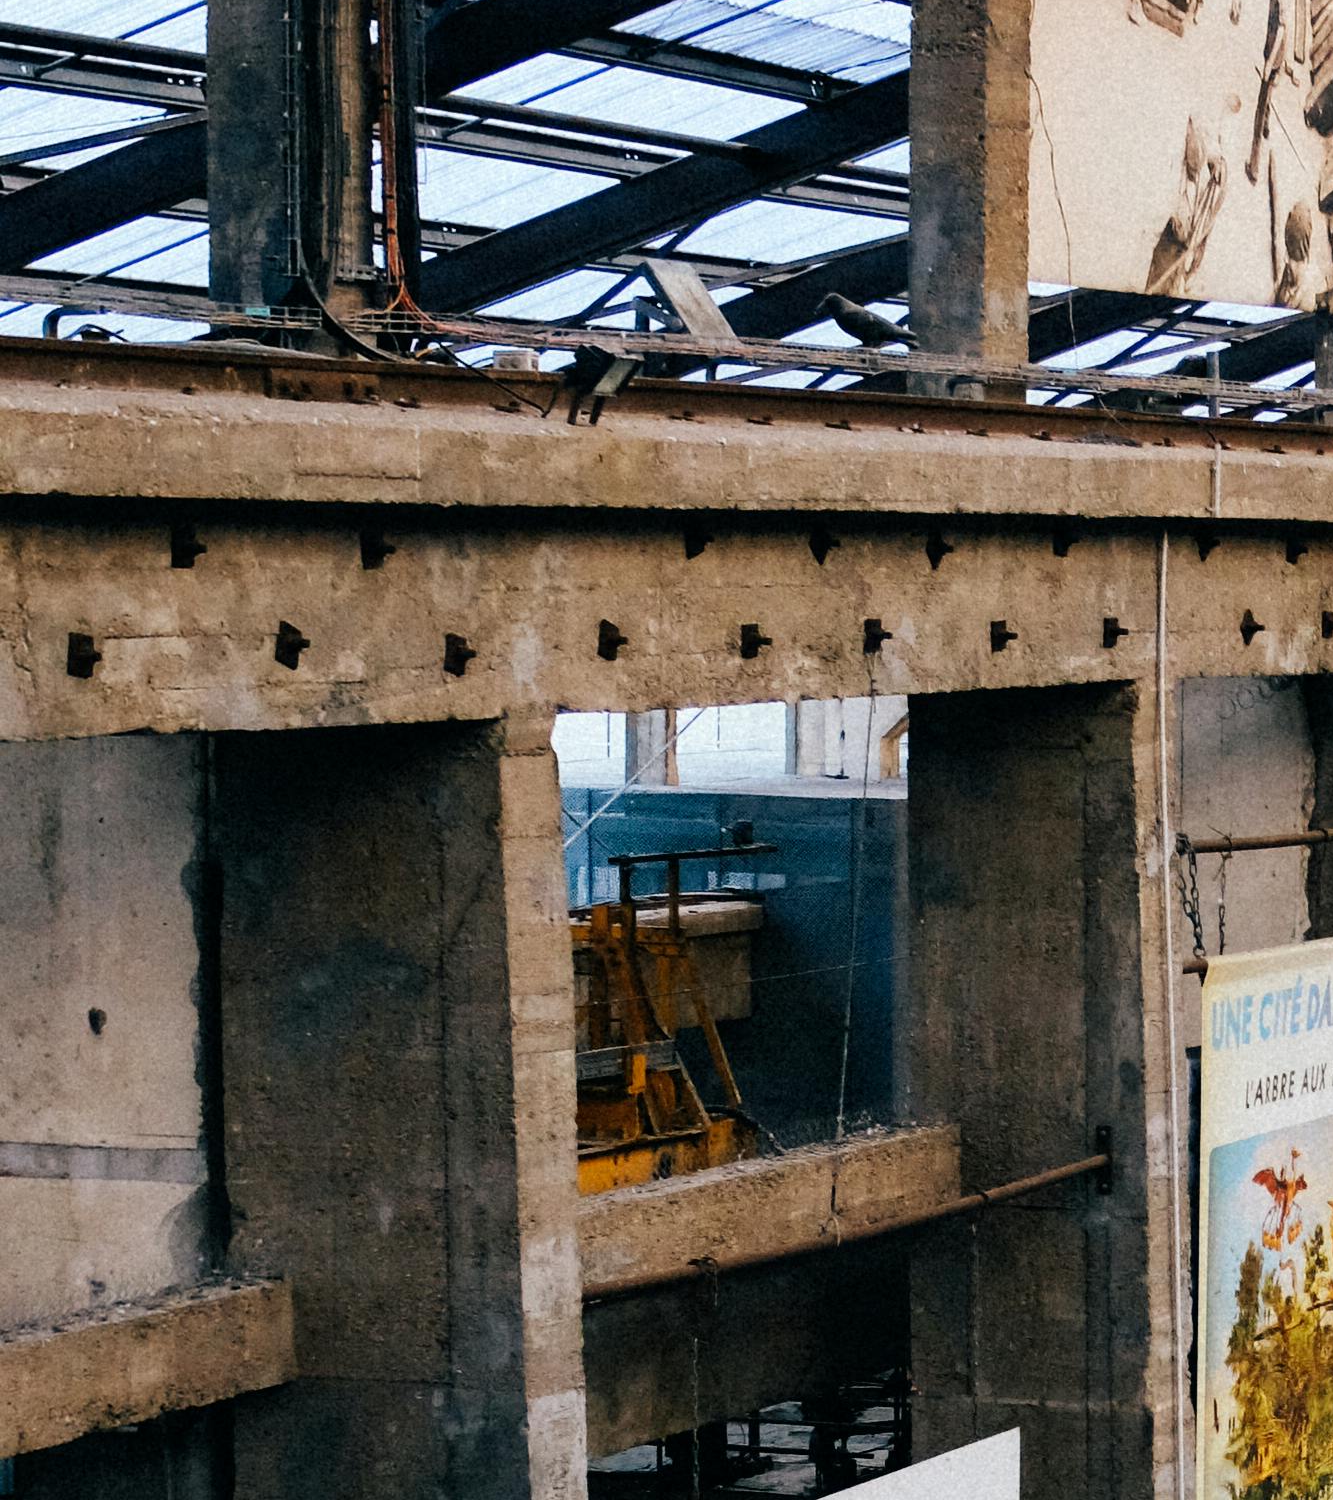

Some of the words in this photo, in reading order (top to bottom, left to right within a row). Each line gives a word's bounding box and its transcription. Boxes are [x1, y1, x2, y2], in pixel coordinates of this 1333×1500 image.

[1211, 994, 1254, 1052] UNE
[1259, 973, 1303, 1041] CITÉ
[1245, 1069, 1296, 1109] L'ARBRE
[1300, 1061, 1327, 1096] AUX
